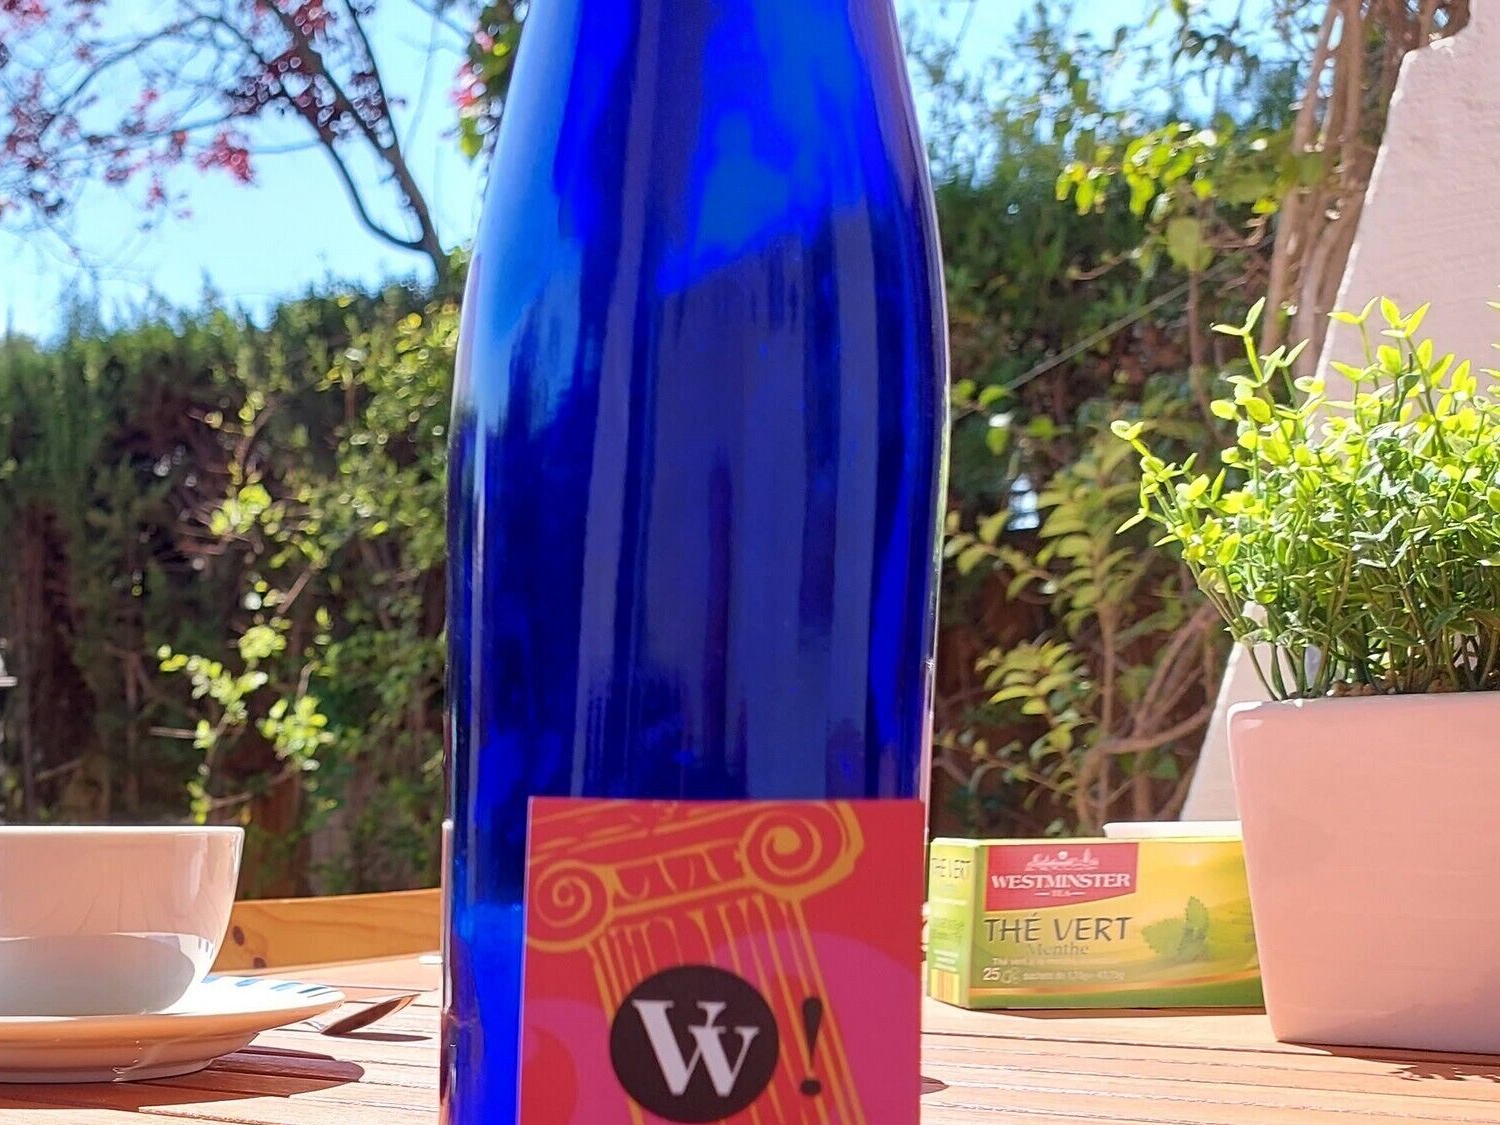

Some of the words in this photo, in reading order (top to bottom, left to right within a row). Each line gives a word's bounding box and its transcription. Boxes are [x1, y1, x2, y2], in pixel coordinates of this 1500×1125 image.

[991, 872, 1131, 890] WESTMINSTER
[984, 912, 1042, 943] THÉ
[1053, 916, 1133, 942] VERT
[982, 966, 1001, 981] 25
